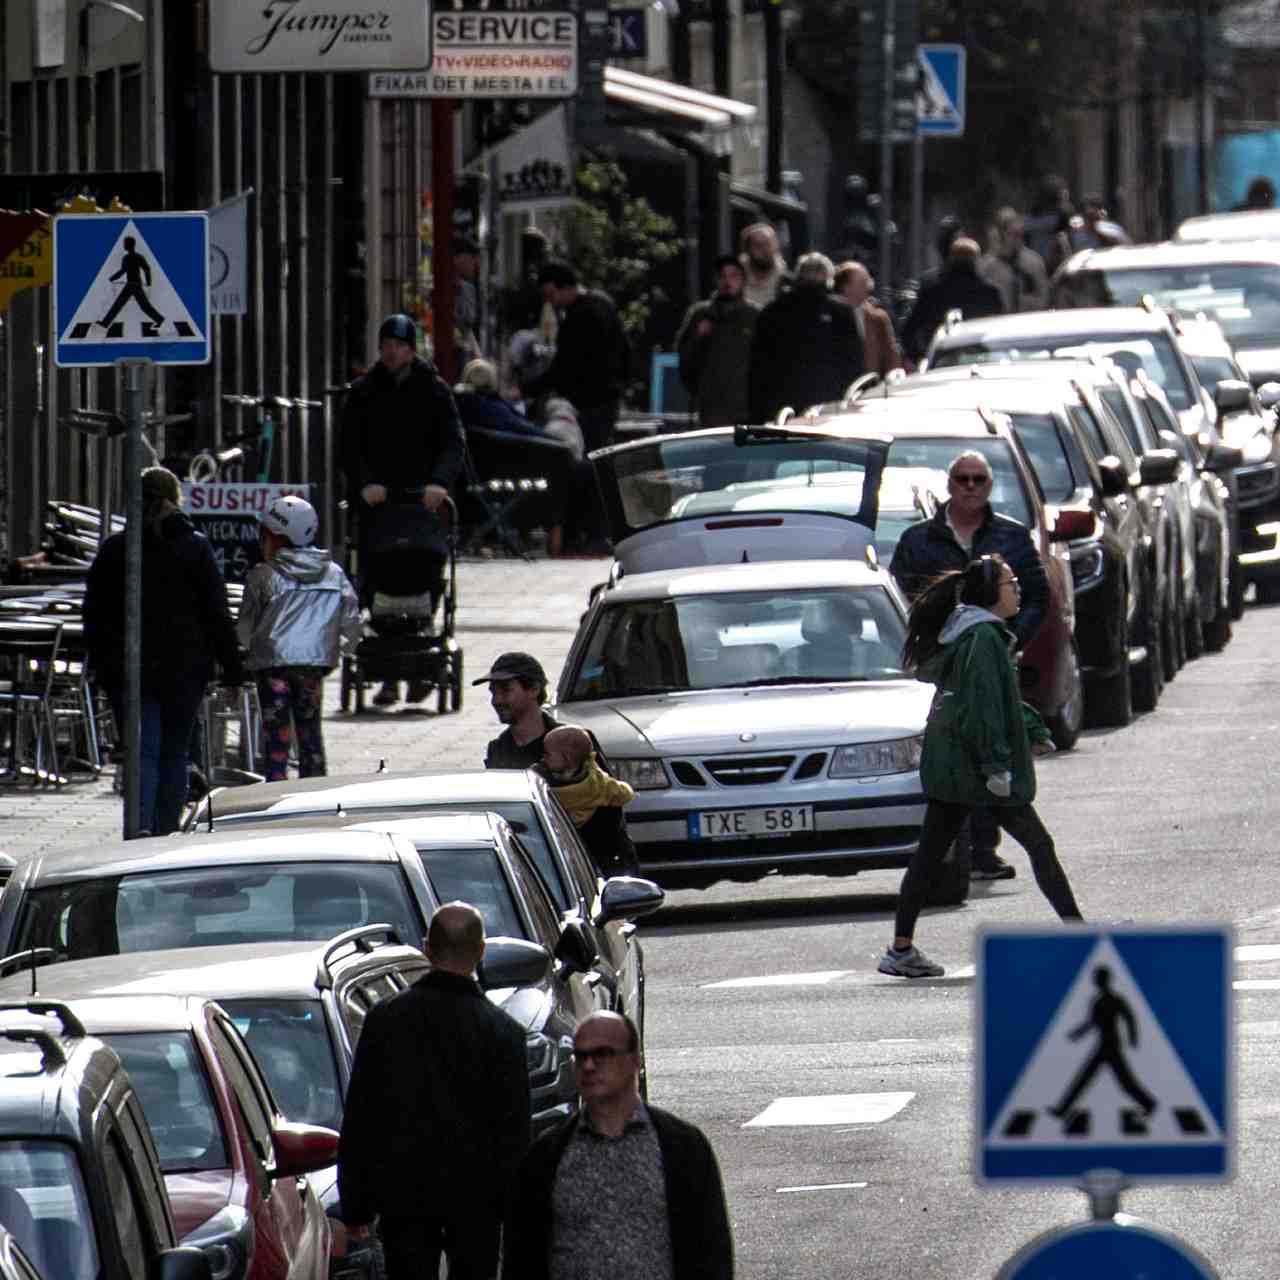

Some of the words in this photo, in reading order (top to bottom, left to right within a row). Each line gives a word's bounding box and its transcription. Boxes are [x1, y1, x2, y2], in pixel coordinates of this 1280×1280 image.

[436, 17, 572, 41] SERVICE
[432, 75, 467, 91] DET
[704, 812, 747, 834] TXE
[764, 807, 807, 831] 581
